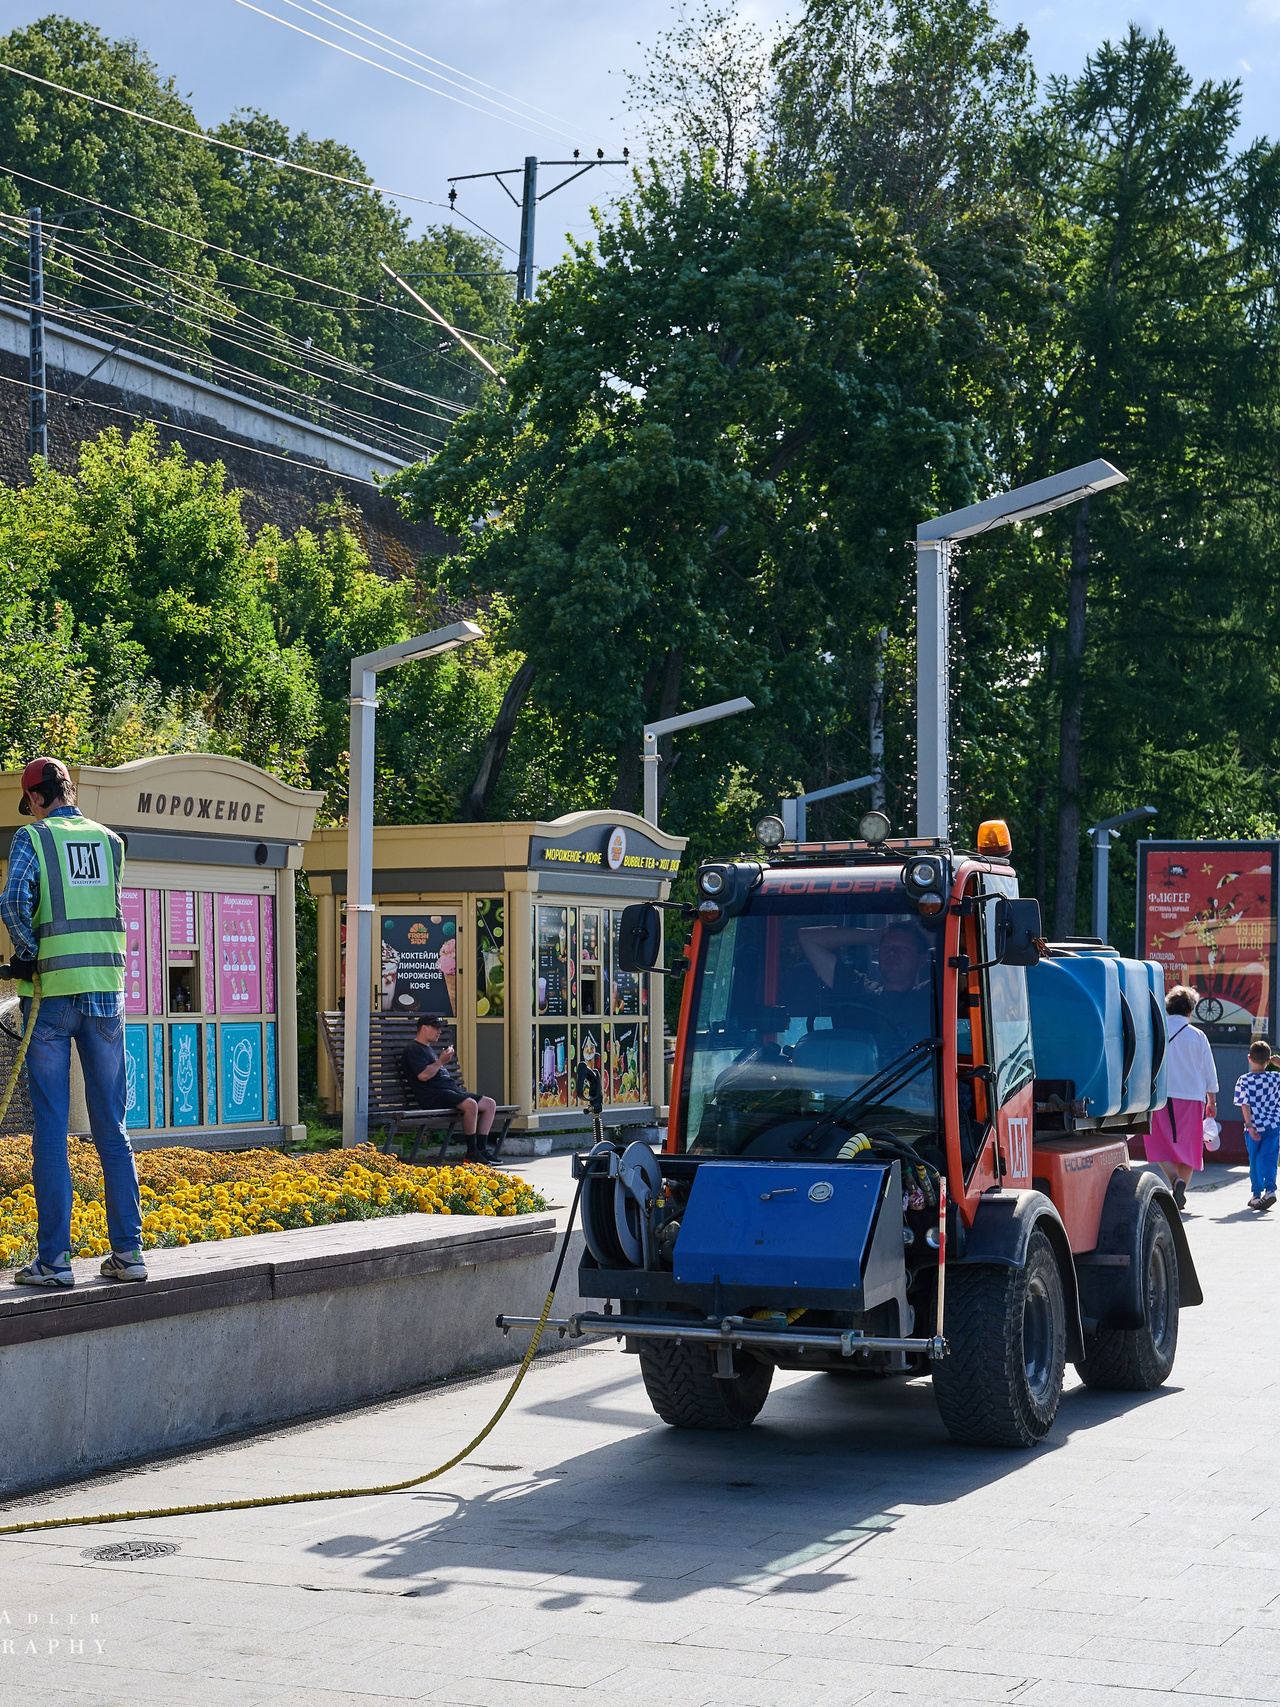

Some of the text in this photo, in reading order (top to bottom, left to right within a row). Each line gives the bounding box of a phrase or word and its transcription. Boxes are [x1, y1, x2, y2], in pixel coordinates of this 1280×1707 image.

[137, 792, 265, 823] МОРОЖЕНОЕ
[544, 848, 602, 864] МОРОЖЕНОЕ КОФЕ
[623, 855, 655, 868] BUBBLE TEA
[659, 858, 670, 870] ХОТ
[761, 878, 897, 894] HOLDER
[1238, 937, 1263, 950] 10.08
[401, 950, 439, 959] КОКТЕЙЛИ
[398, 962, 442, 970] ЛИМОНАДЫ
[397, 972, 443, 980] МОРОЖЕНОЕ
[1064, 1155, 1093, 1173] HOLDER
